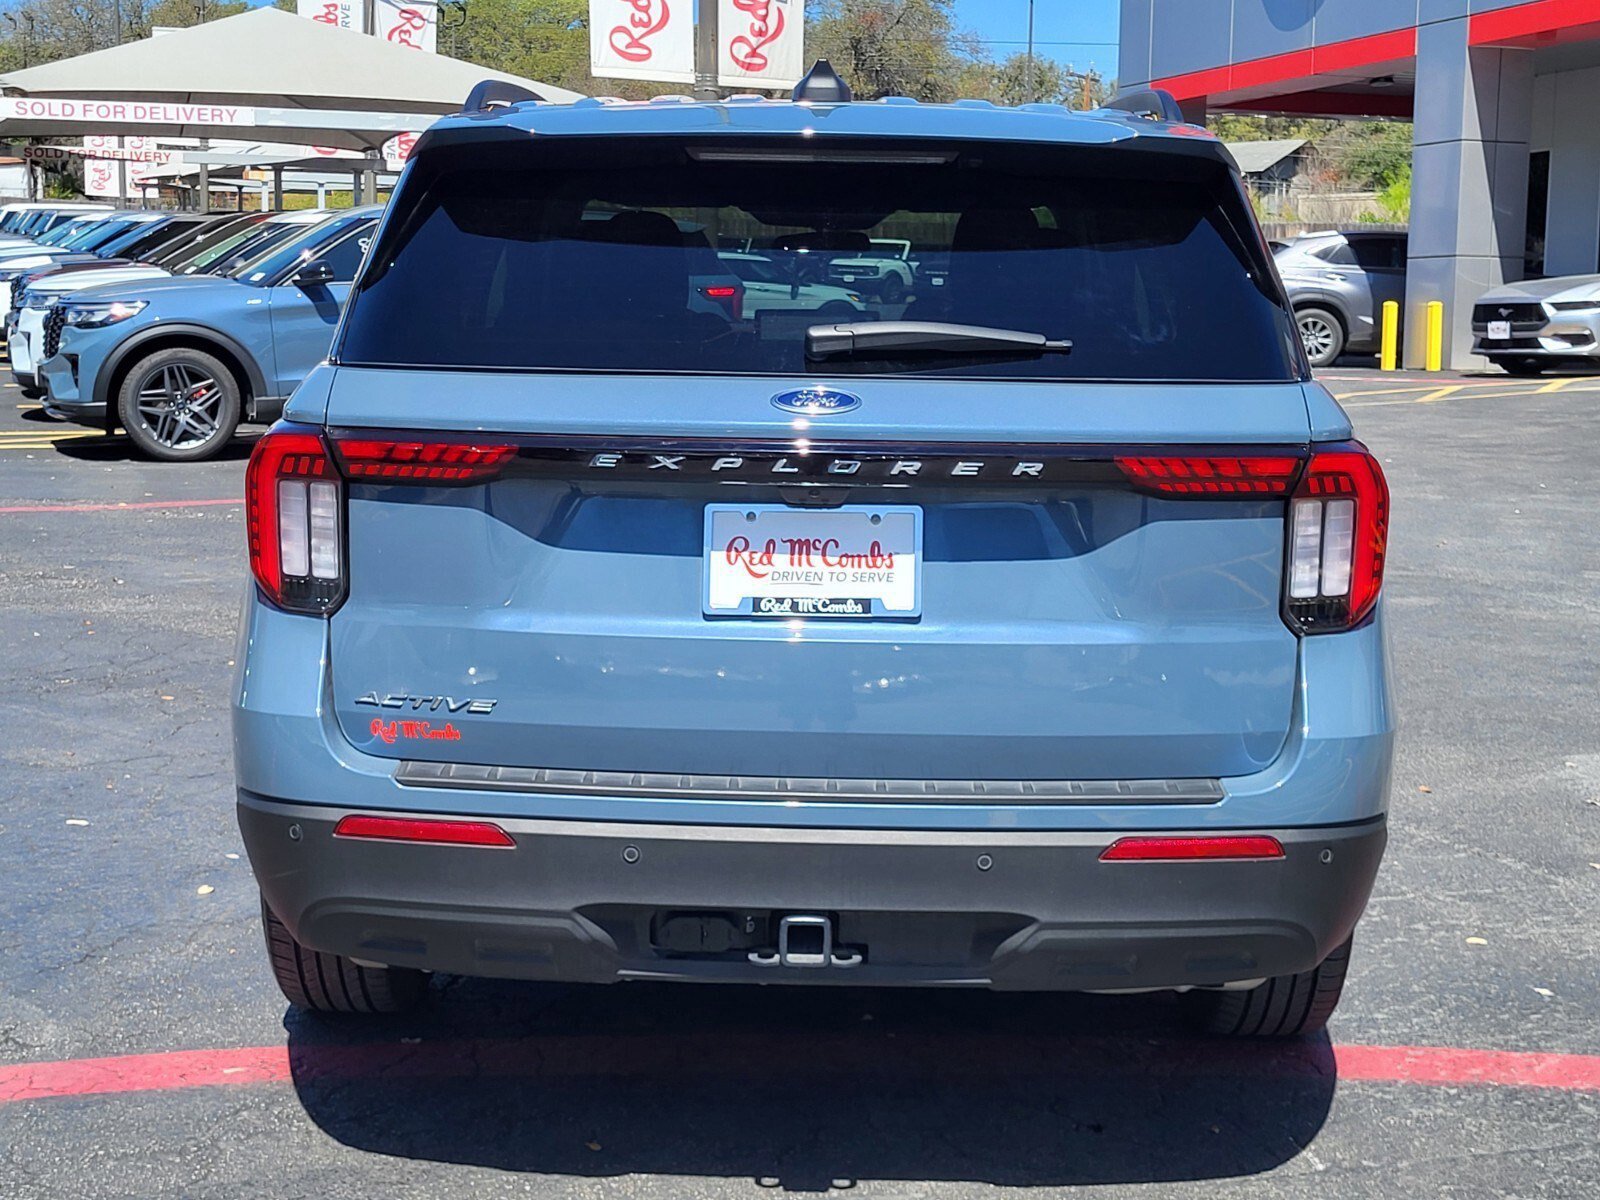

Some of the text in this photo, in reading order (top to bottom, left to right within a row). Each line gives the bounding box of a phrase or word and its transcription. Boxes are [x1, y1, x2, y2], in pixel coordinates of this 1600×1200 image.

[341, 3, 351, 28] RVE
[15, 100, 238, 123] SOLD FOR DELIVERY
[23, 146, 64, 159] SOLD
[69, 149, 98, 161] FOR
[101, 150, 172, 163] DELIVERY
[791, 389, 842, 408] Ford
[588, 452, 1045, 477] EXPLORER
[725, 535, 894, 579] Red McCombs
[770, 571, 895, 584] DRIVEN TO SERVE
[760, 597, 863, 614] Red McCombs
[354, 690, 498, 715] ACTIVE
[370, 718, 398, 745] Red
